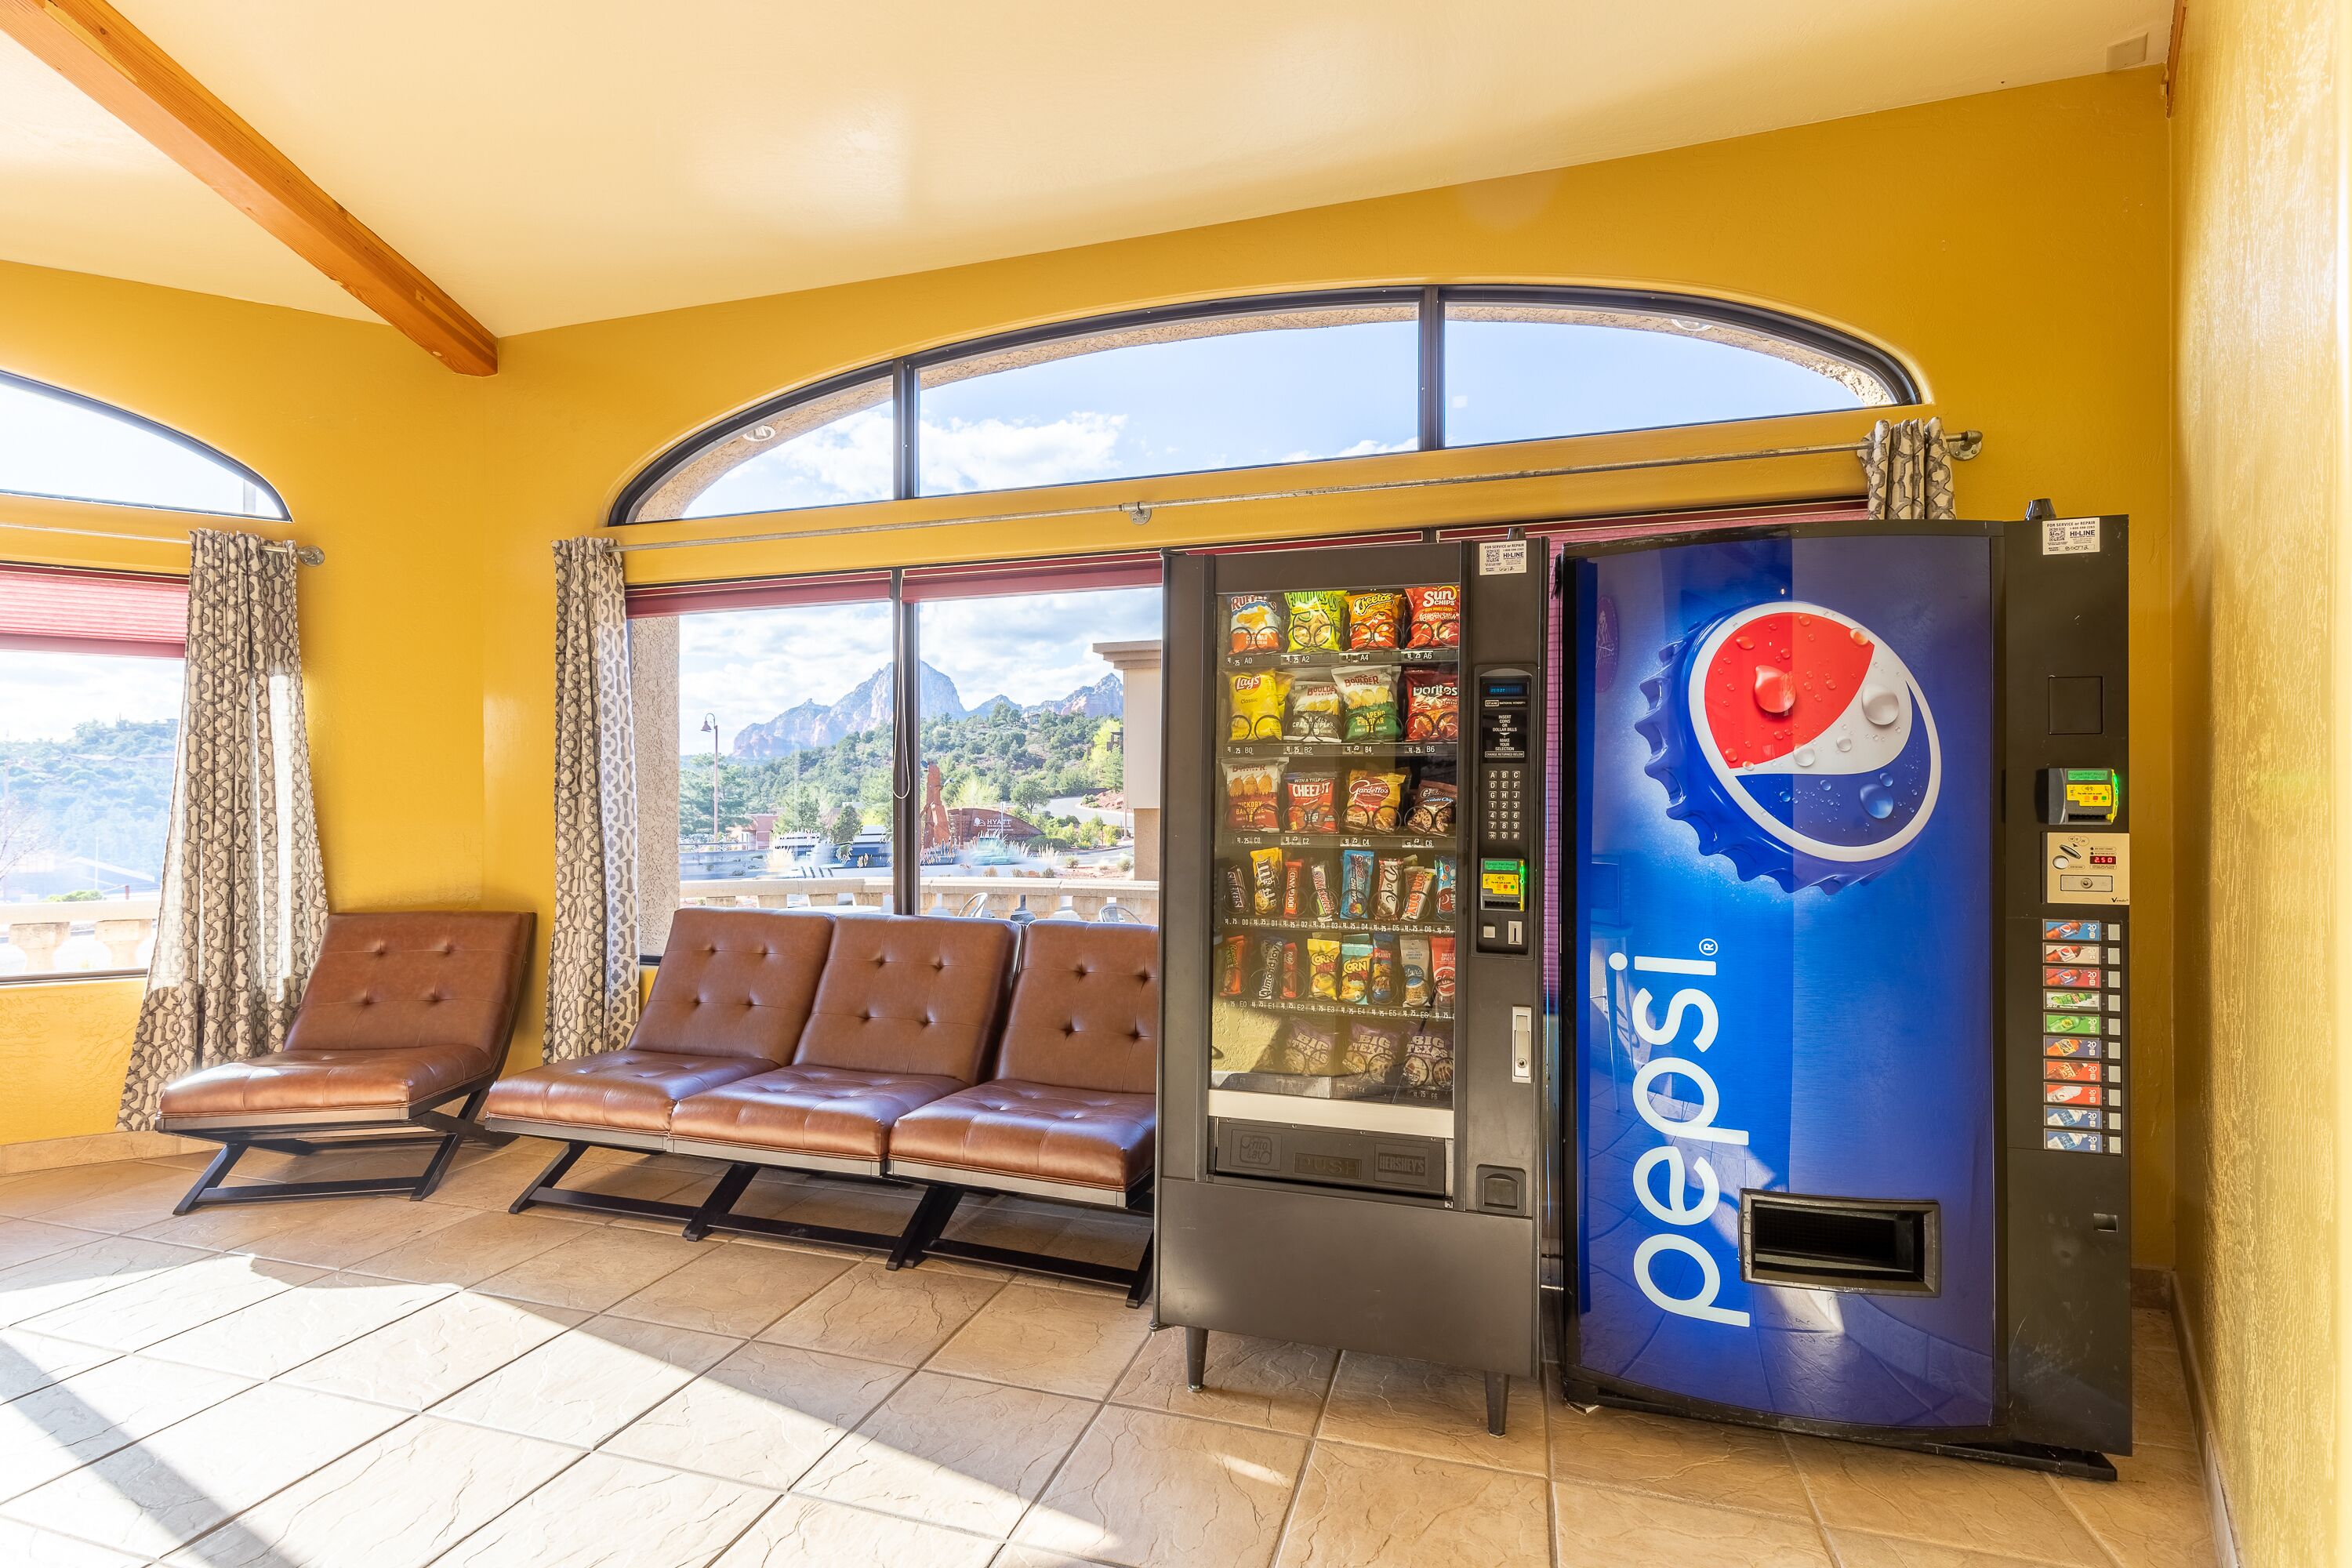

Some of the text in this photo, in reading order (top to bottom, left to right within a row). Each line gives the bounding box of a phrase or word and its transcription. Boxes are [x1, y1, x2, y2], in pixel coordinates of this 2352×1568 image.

[1231, 595, 1276, 612] RUFFS
[1344, 675, 1379, 688] BOULDER
[1349, 779, 1388, 801] Gardetto's
[1311, 953, 1335, 966] CORN
[1344, 960, 1367, 973] CORN
[1297, 1033, 1329, 1052] BIG
[1359, 1034, 1391, 1049] BIG
[1411, 1035, 1445, 1048] BIG
[1291, 1039, 1329, 1065] TEXAS
[1406, 1044, 1448, 1058] TEXAS
[1609, 952, 1751, 1328] pepsi
[1379, 1155, 1425, 1173] HERSHEY'S
